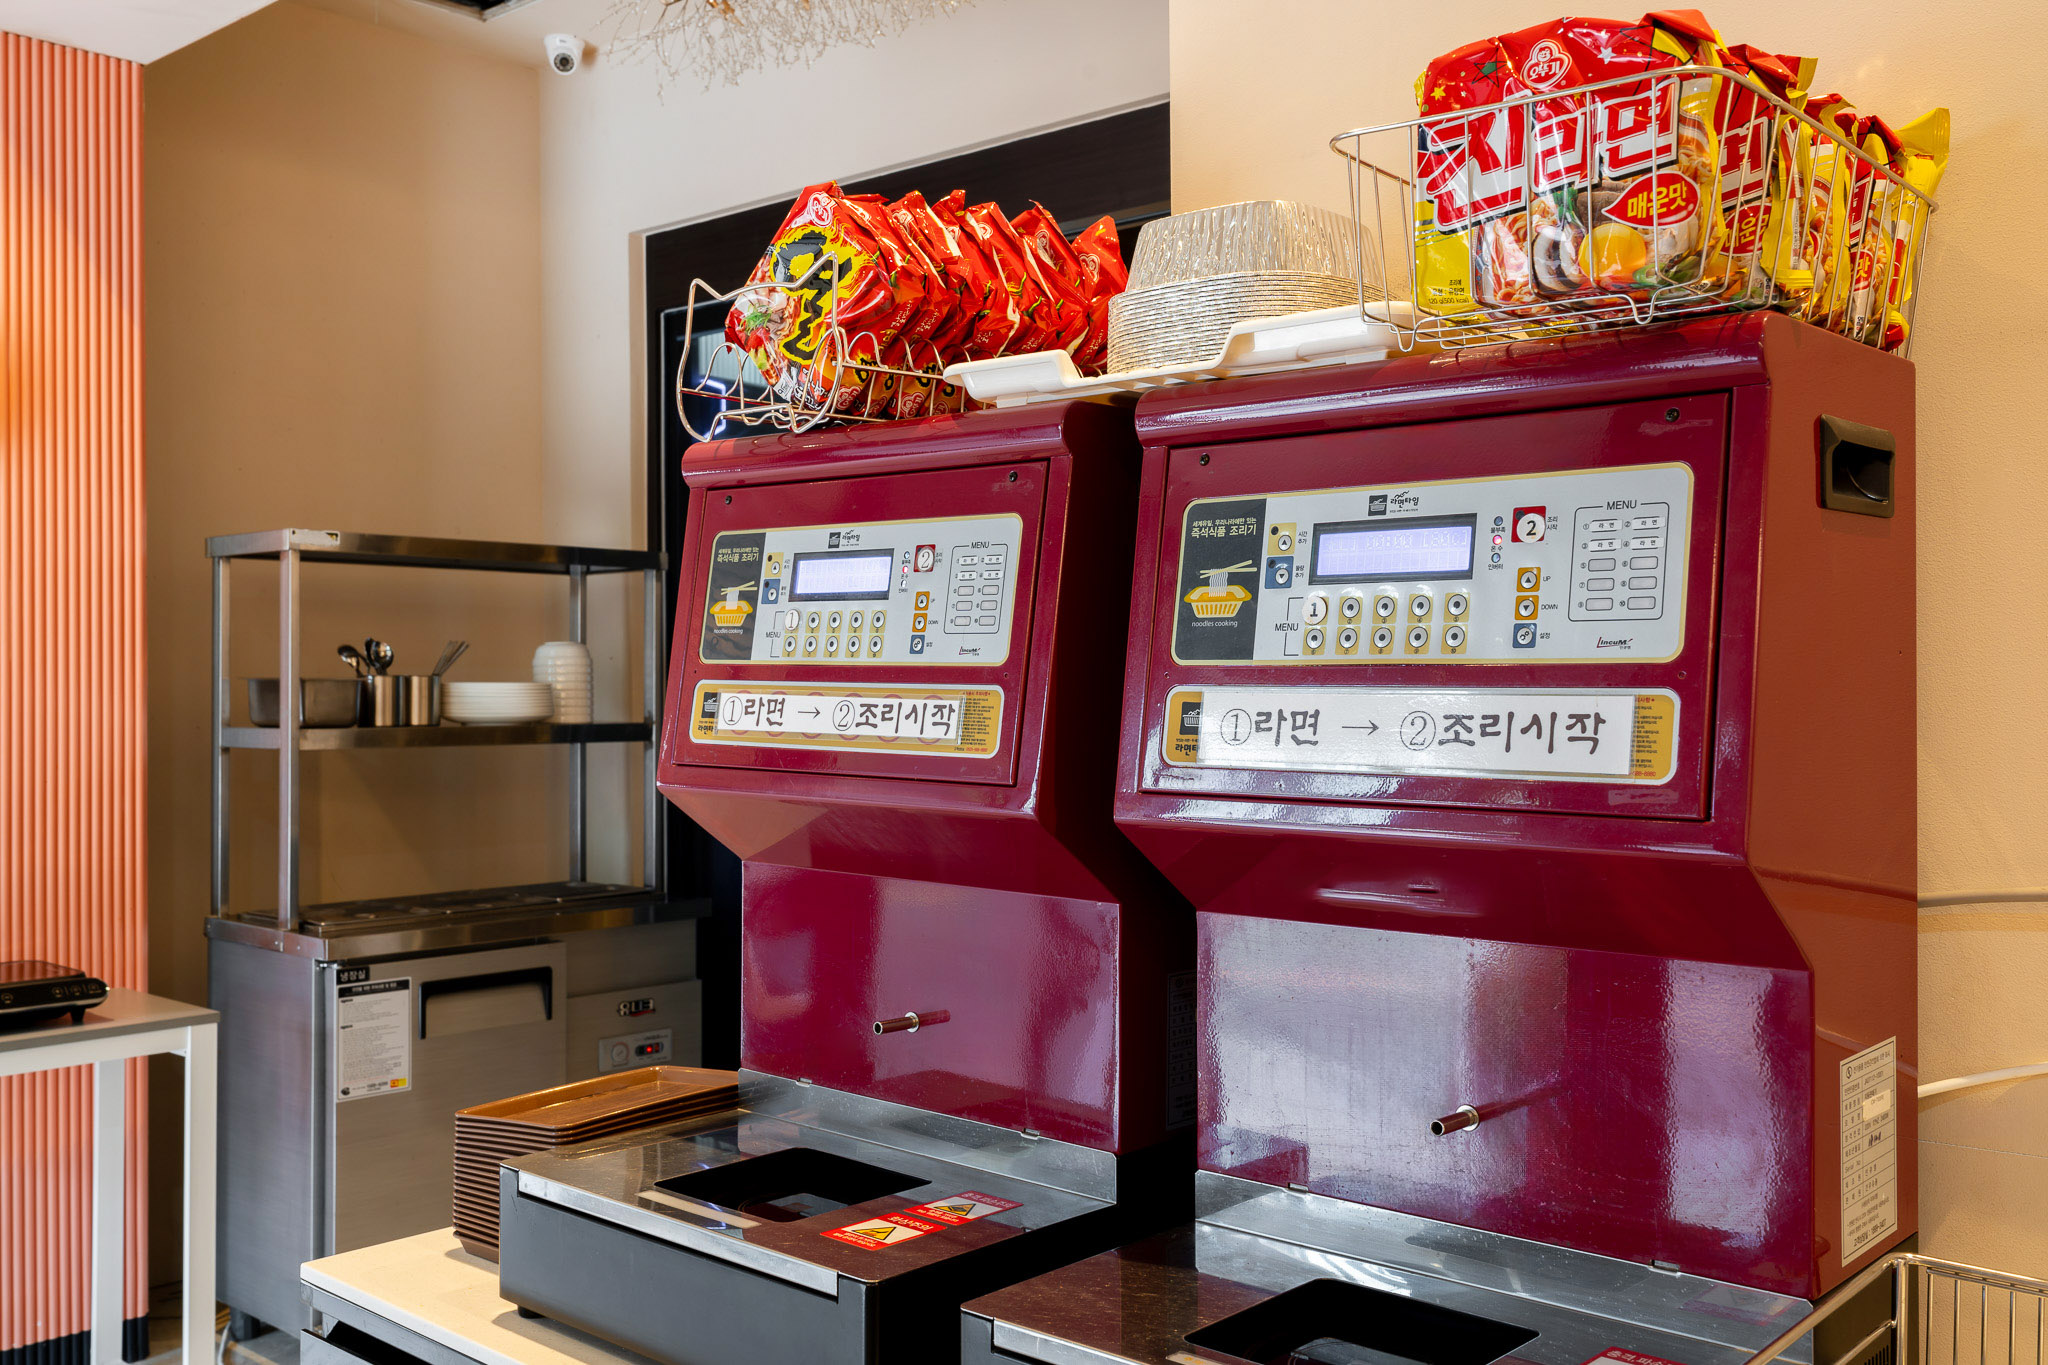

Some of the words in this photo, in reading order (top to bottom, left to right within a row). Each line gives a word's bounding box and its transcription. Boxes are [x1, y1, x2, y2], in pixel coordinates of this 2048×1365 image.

[1529, 60, 1561, 81] 오뚜기
[1427, 78, 1680, 234] 진라면
[1627, 181, 1687, 219] 매운맛
[1606, 500, 1637, 510] MENU
[1191, 526, 1227, 539] 즉석식품
[1229, 524, 1257, 536] 조리기
[1526, 520, 1537, 536] 2
[921, 551, 930, 569] 2
[1309, 602, 1319, 618] 1
[1214, 619, 1238, 628] cooking
[1274, 623, 1299, 632] MENU
[765, 631, 781, 639] MENU
